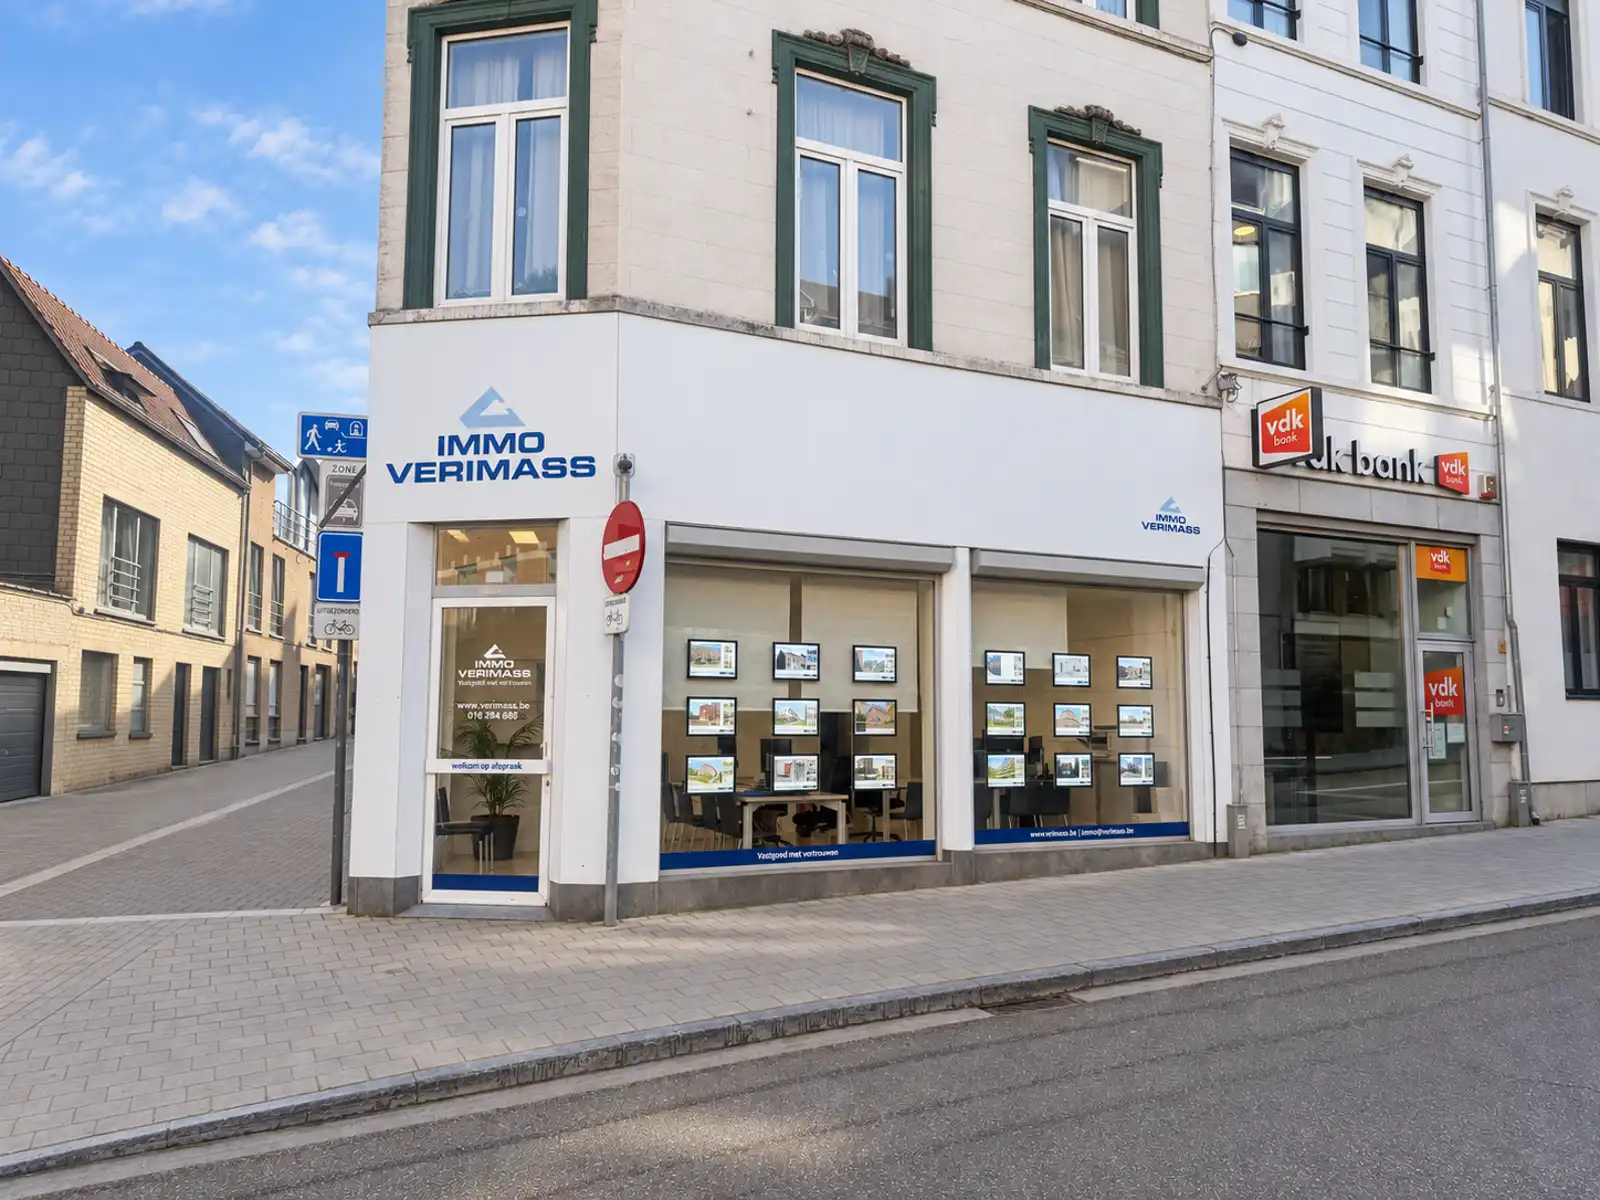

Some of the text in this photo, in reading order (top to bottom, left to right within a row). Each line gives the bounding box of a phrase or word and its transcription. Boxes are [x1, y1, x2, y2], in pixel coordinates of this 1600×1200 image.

[1265, 408, 1304, 435] vdk
[437, 431, 546, 456] IMMO
[1273, 432, 1298, 446] bank
[331, 464, 358, 473] ZONE
[1350, 439, 1429, 484] bank
[1441, 458, 1466, 477] vdk
[385, 456, 597, 484] VERIMASS
[1155, 513, 1187, 524] IMMO
[1141, 521, 1201, 535] VERIMASS
[1430, 549, 1450, 564] vdk
[475, 660, 515, 669] IMMO
[458, 669, 532, 678] VERIMASS
[1428, 676, 1459, 696] vdk
[1435, 699, 1454, 708] bank
[481, 763, 490, 771] op
[788, 850, 802, 858] met
